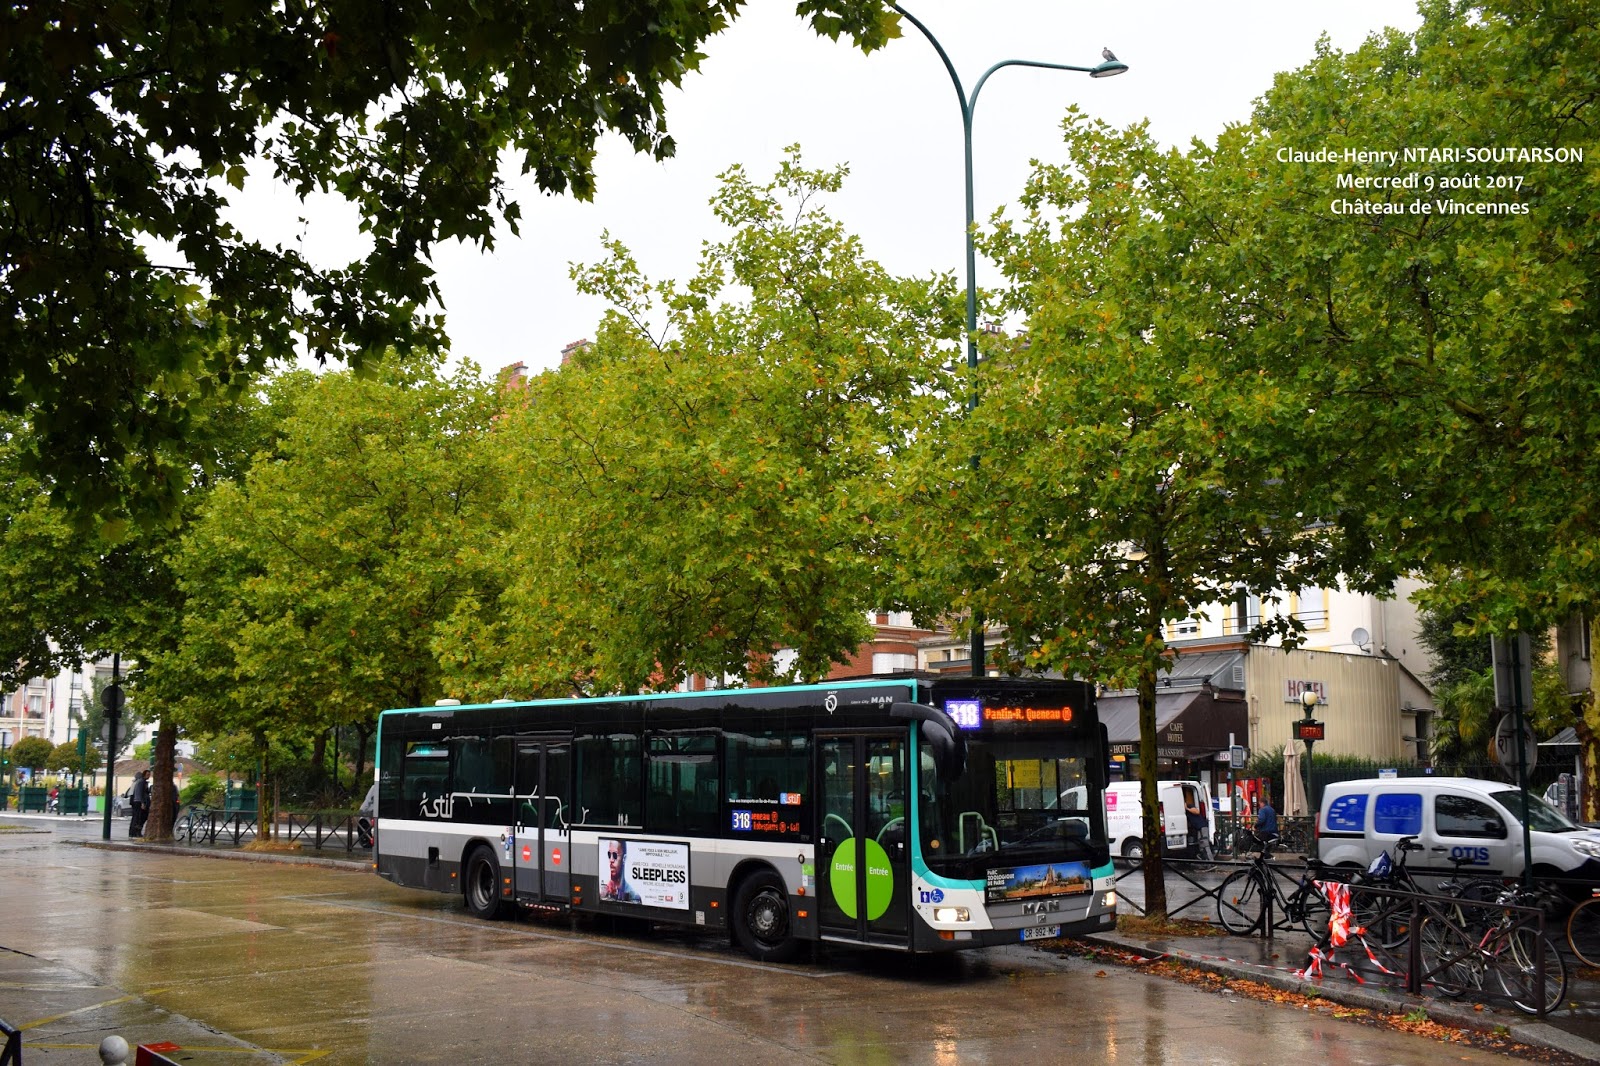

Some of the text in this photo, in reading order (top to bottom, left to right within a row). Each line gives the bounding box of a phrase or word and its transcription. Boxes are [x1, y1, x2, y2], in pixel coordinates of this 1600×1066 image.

[1288, 680, 1326, 699] HOEL
[949, 703, 977, 726] 318
[984, 706, 1025, 720] Pantin-R.
[1026, 708, 1061, 721] Queneau
[1169, 722, 1184, 732] CAFE
[1167, 733, 1184, 743] HOTEL
[1113, 745, 1135, 753] HOTEL
[1157, 748, 1184, 757] BRASSERIE
[733, 812, 750, 829] 318
[1451, 846, 1490, 860] OTIS
[835, 863, 854, 871] Entrée
[869, 867, 889, 876] Entrée
[632, 867, 686, 883] SLEEPLESS
[1021, 900, 1060, 915] MAN
